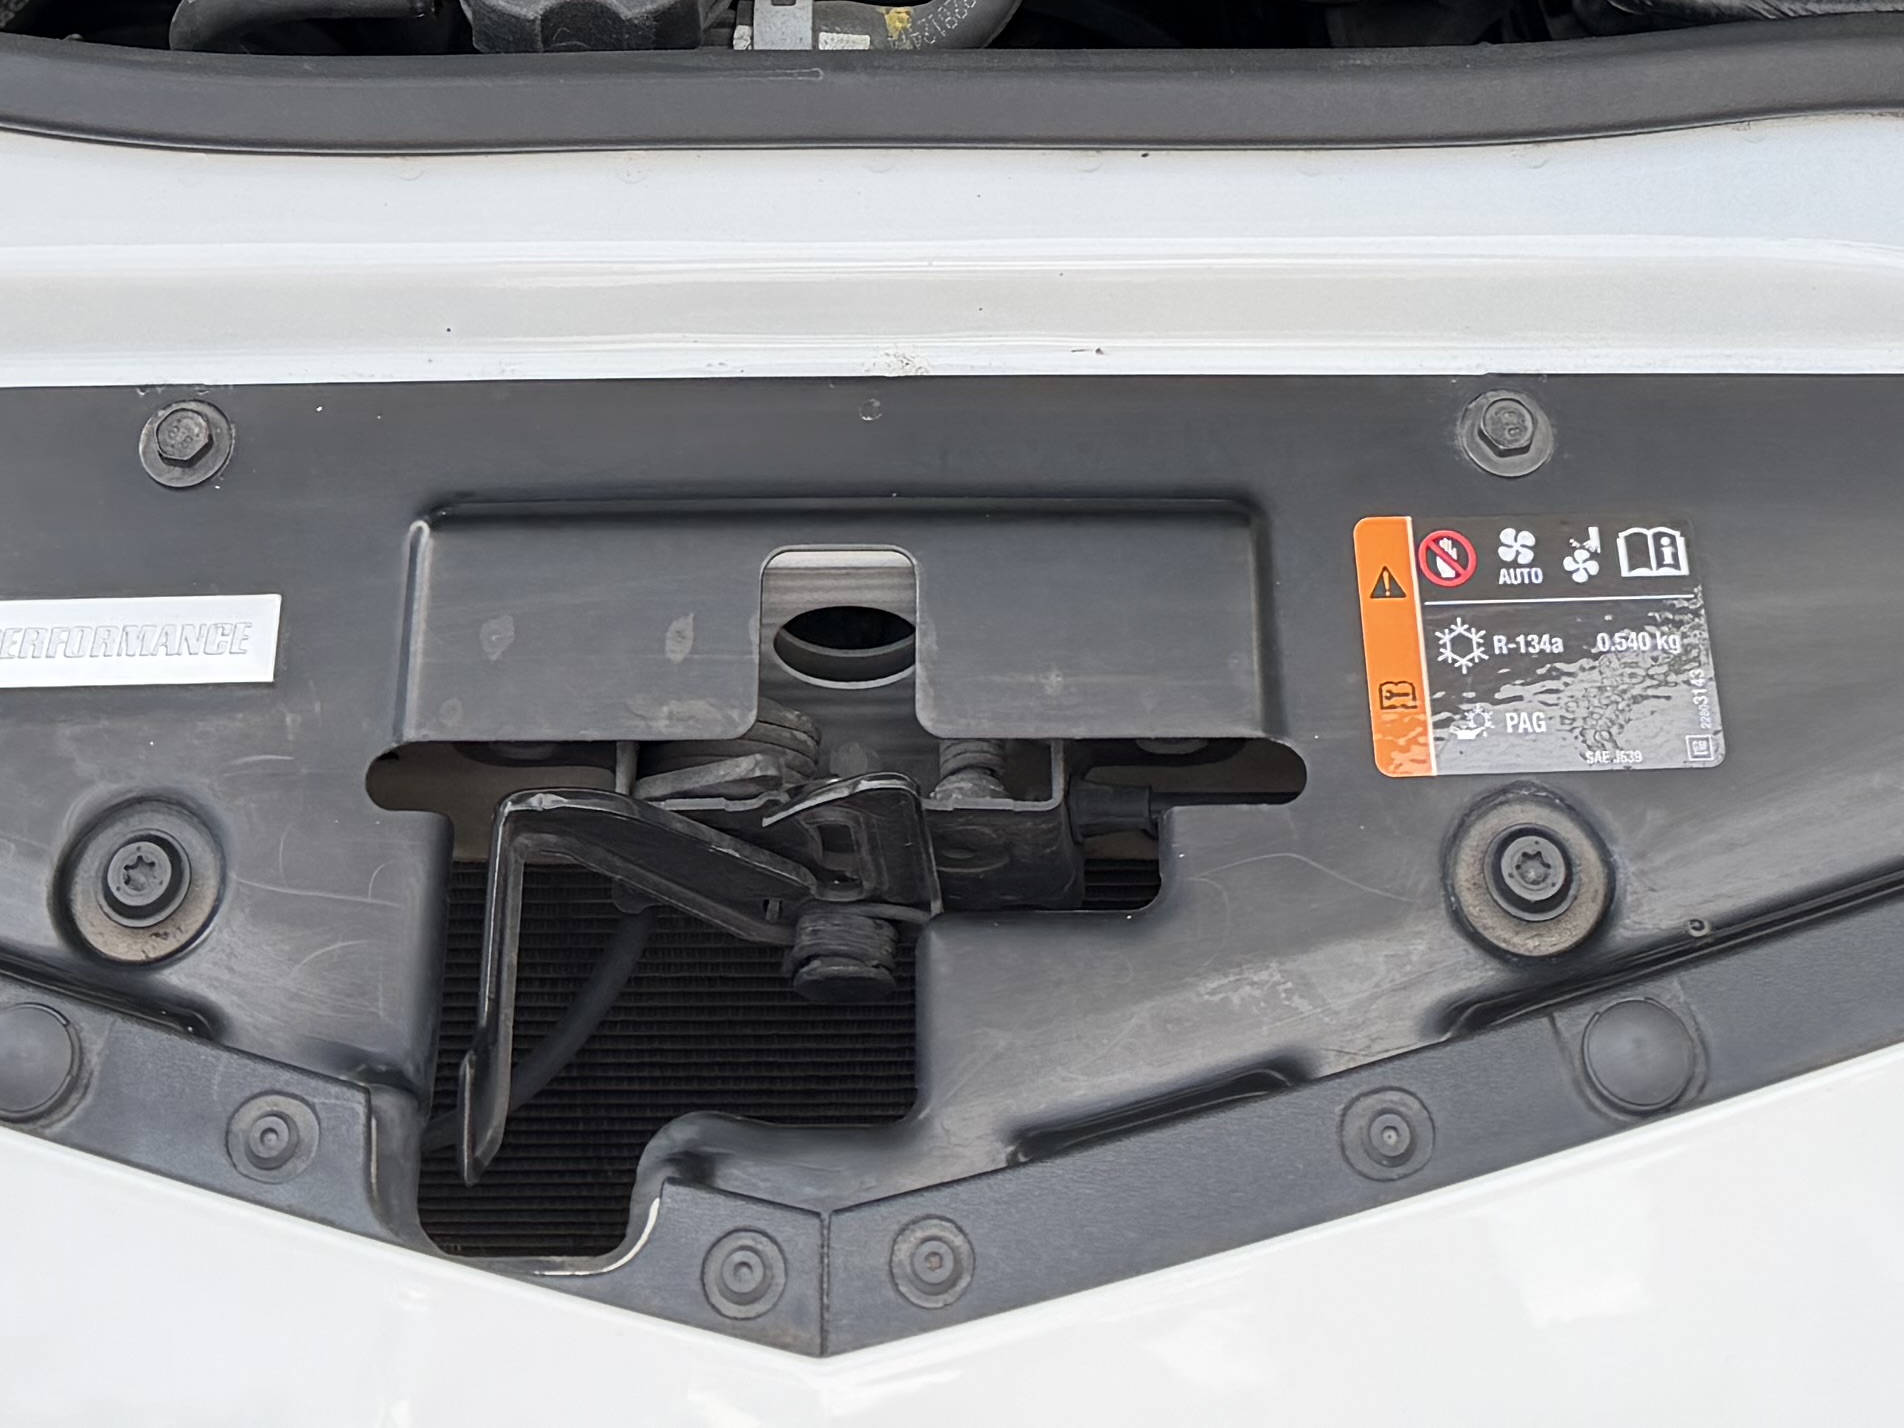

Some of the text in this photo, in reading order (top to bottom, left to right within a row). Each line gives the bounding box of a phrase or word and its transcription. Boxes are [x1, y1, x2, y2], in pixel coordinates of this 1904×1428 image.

[1498, 567, 1544, 585] AUTO
[1493, 634, 1564, 654] R-134a
[1654, 629, 1682, 655] kg
[1505, 712, 1547, 733] PAG
[1585, 750, 1609, 765] SAE
